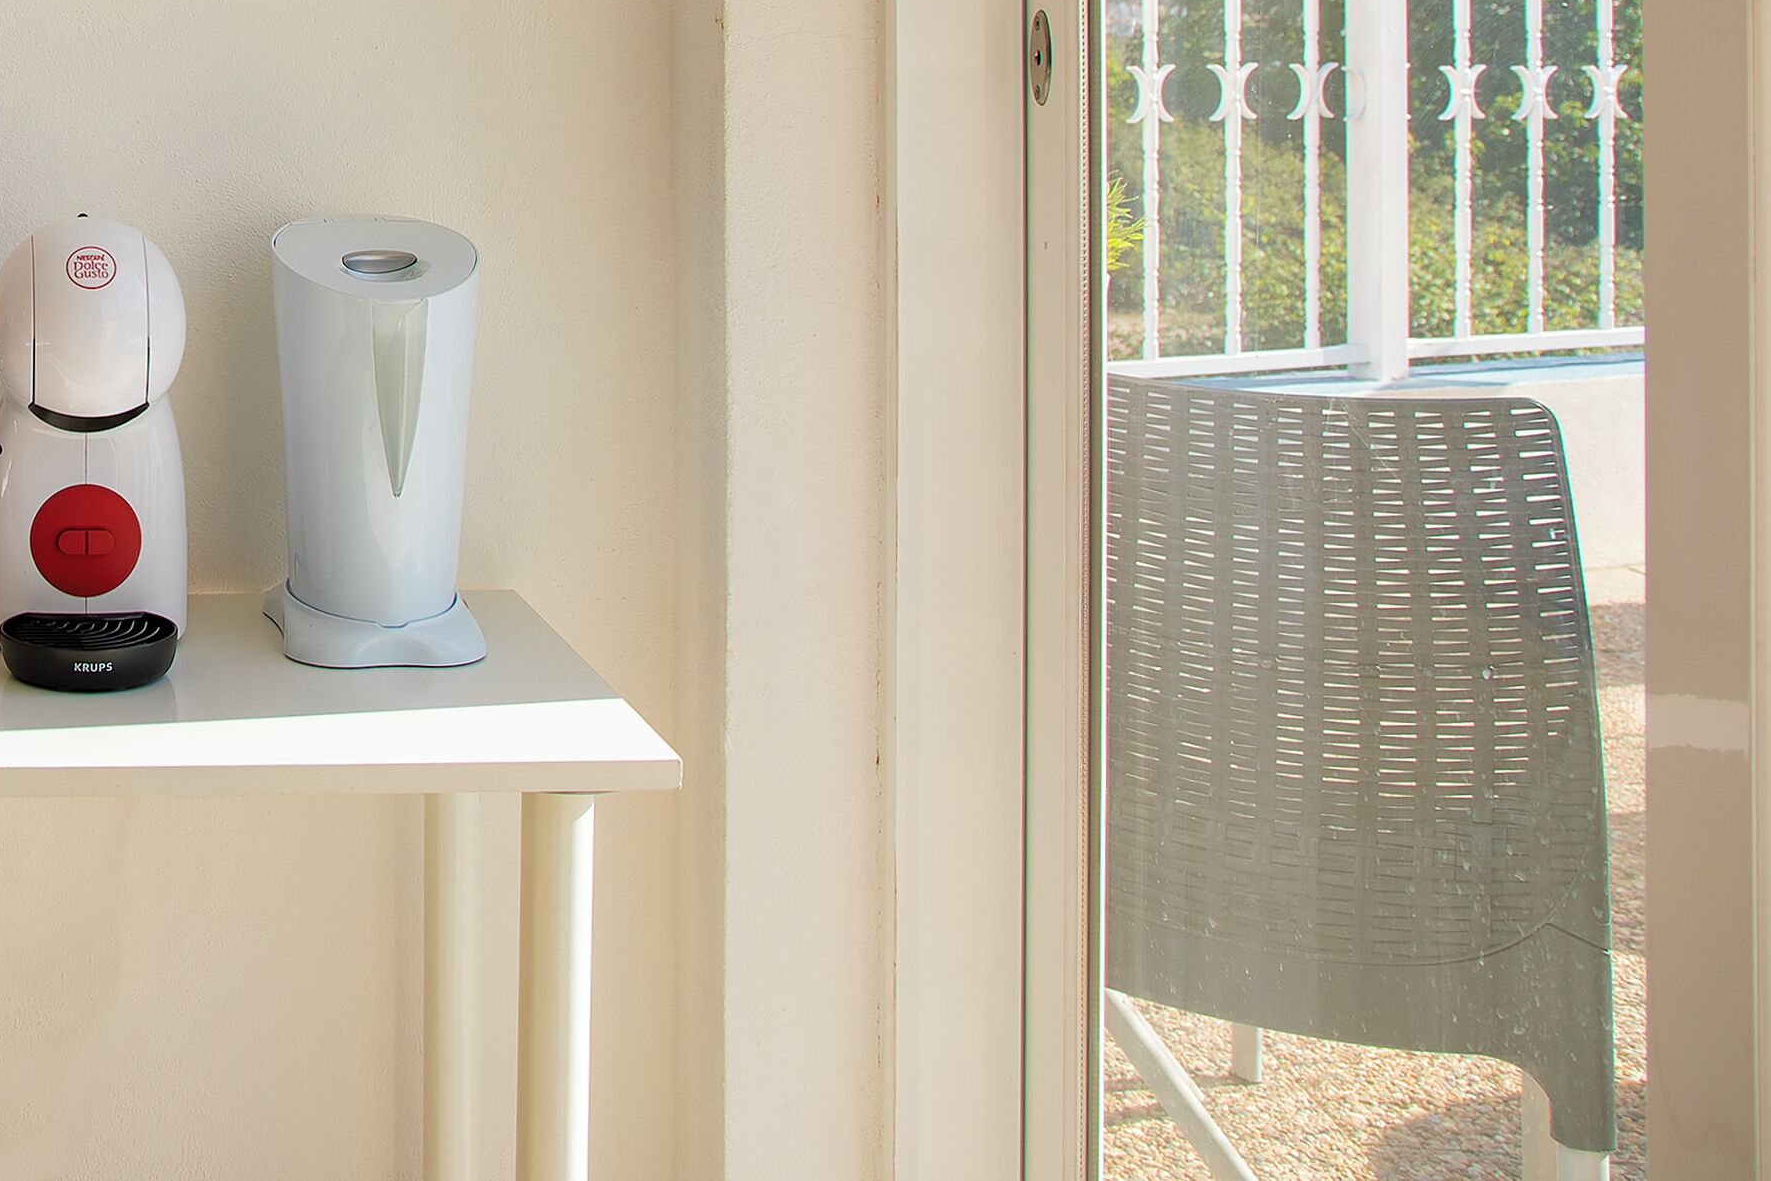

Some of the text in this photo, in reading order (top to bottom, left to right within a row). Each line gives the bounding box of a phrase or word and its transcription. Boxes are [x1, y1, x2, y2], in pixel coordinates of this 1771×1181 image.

[73, 260, 109, 271] Dolce
[74, 269, 109, 279] Gusto
[74, 662, 113, 672] KRUPS
